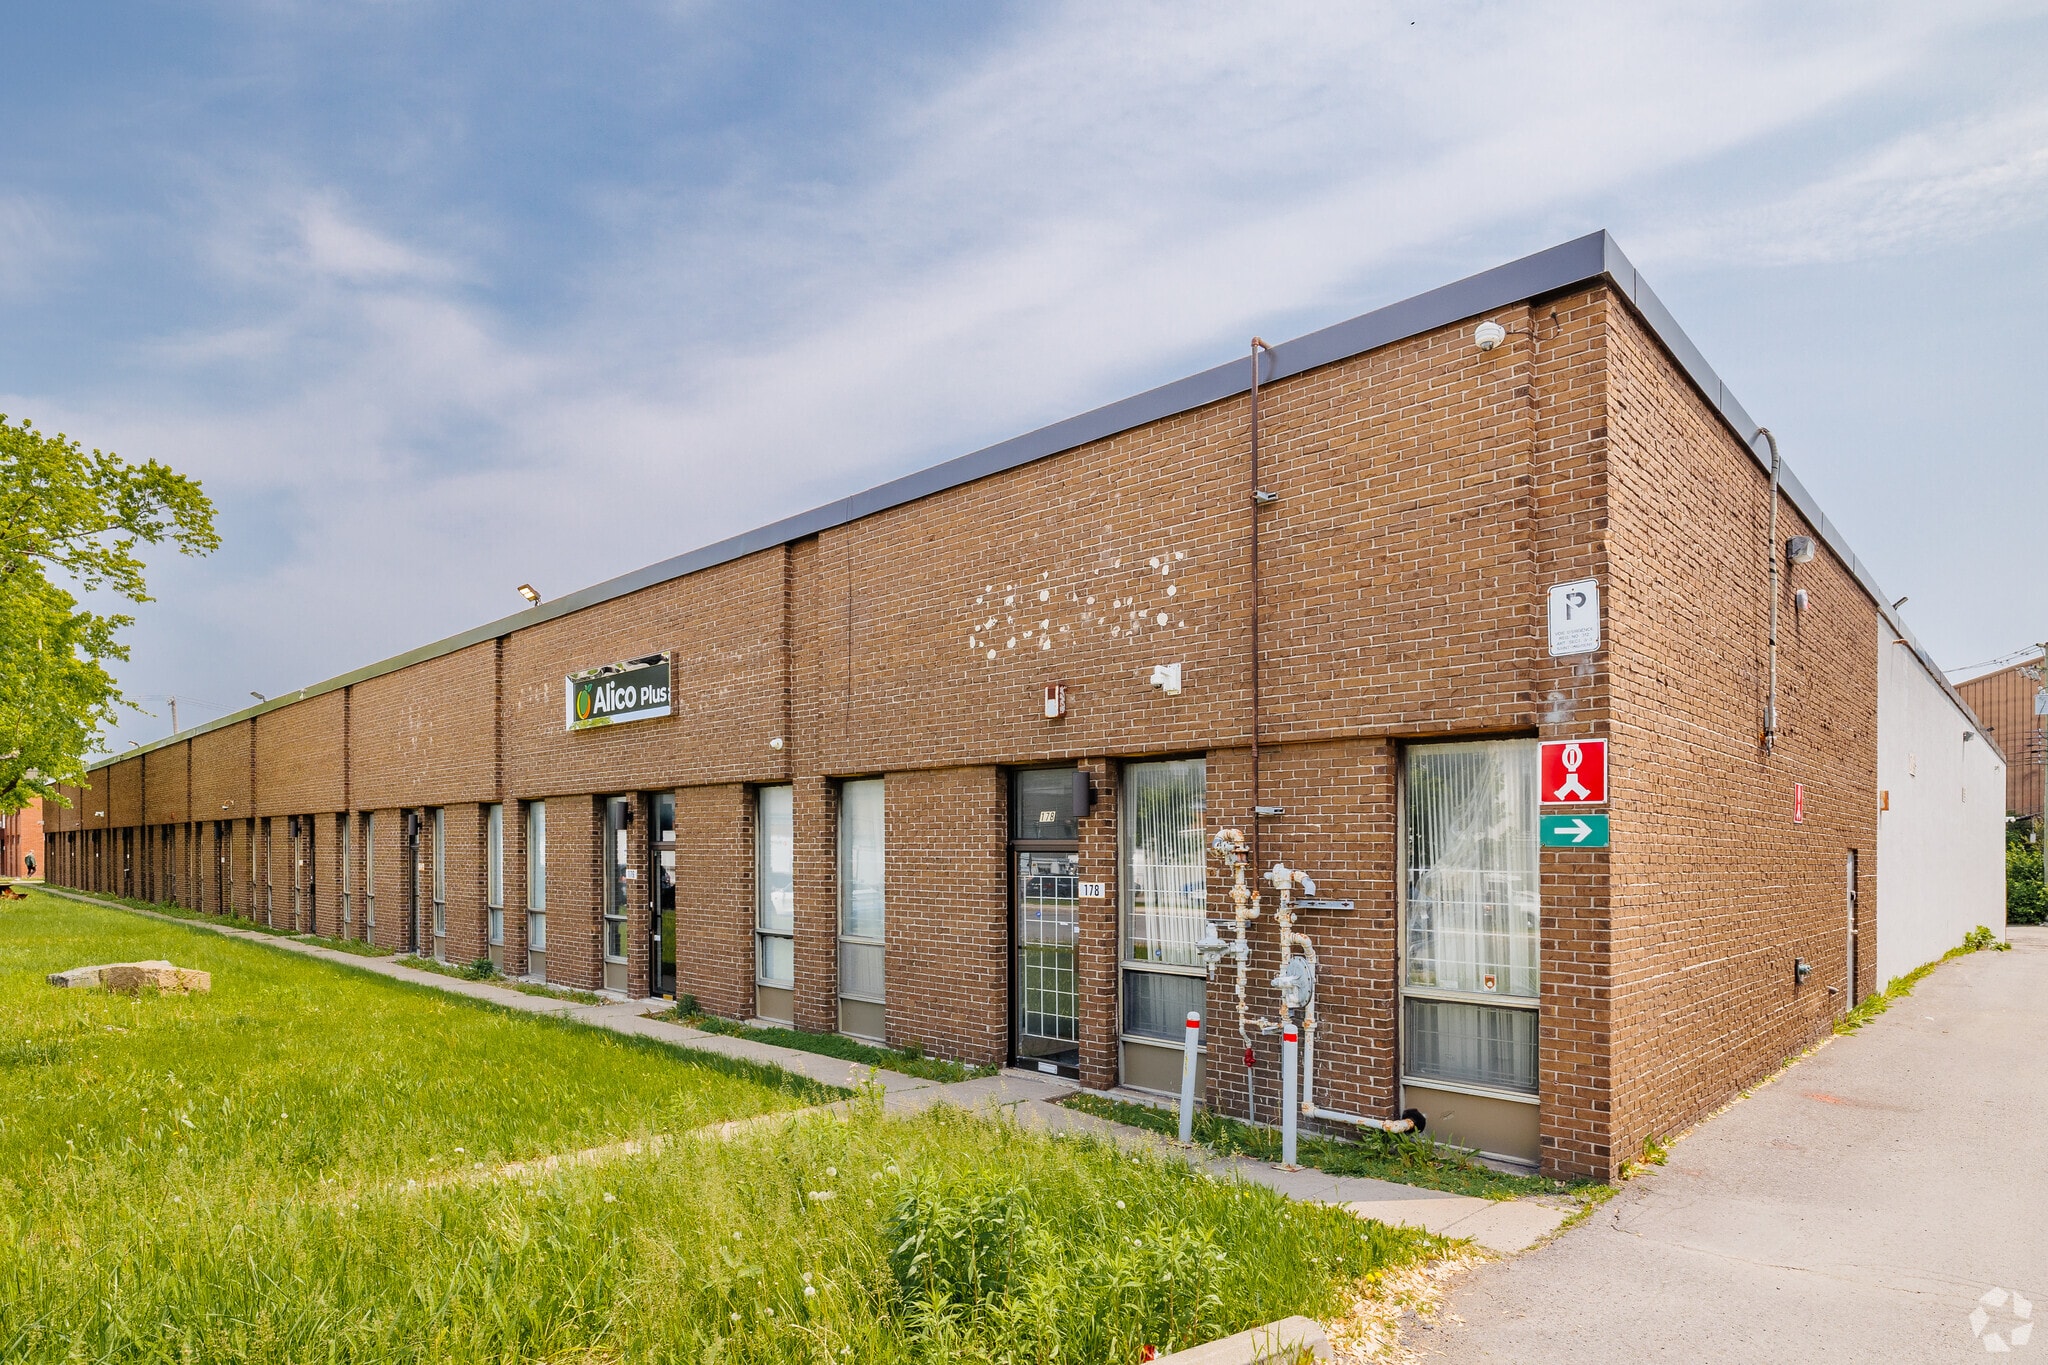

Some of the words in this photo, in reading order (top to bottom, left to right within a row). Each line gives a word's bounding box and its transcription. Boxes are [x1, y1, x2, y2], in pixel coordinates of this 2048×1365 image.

[593, 680, 637, 714] Alico
[640, 685, 668, 706] Plus
[1041, 812, 1054, 821] 178
[1084, 884, 1100, 897] 178
